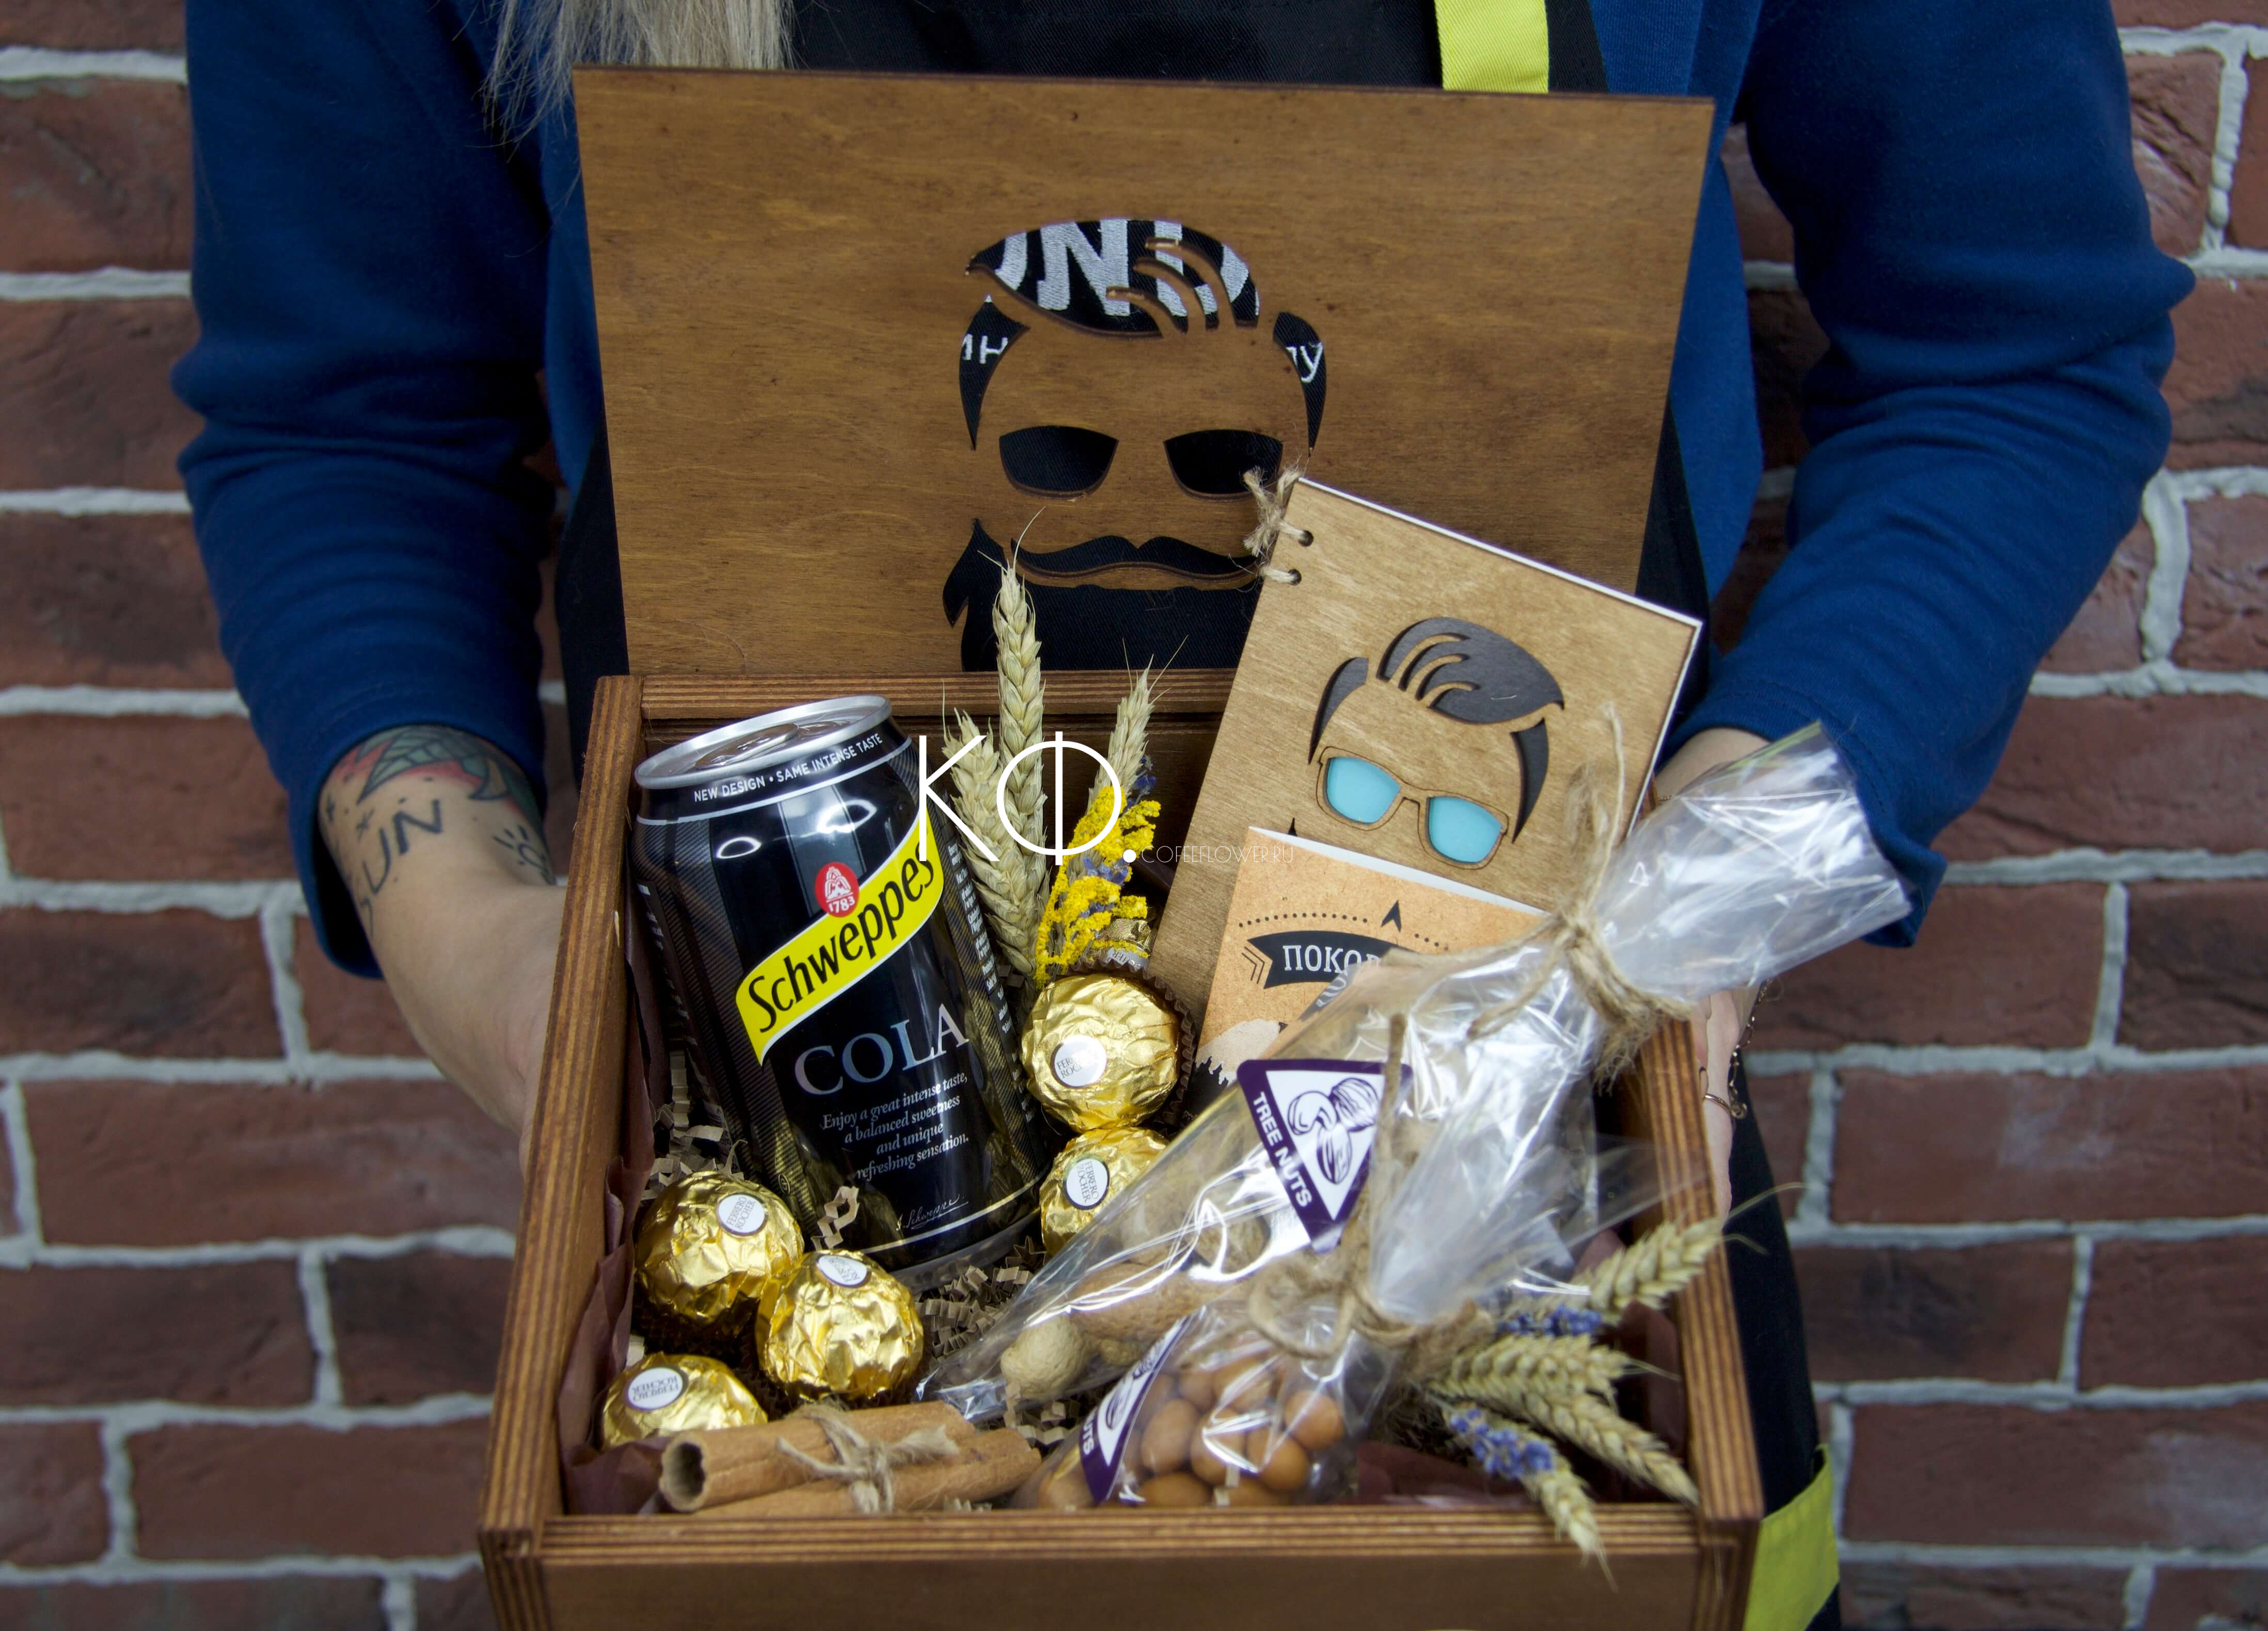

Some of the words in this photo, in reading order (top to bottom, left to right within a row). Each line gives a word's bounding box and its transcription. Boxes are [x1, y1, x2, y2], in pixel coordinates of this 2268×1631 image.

[694, 787, 718, 803] NEW
[722, 776, 766, 797] DESIGN
[776, 765, 811, 783] SAME
[812, 746, 857, 772] INTENSE
[855, 733, 883, 753] TASTE
[829, 896, 855, 913] 1783
[748, 842, 934, 1033] Schweppes
[795, 1003, 969, 1095] COLA
[820, 1111, 857, 1130] Enjoy
[860, 1111, 868, 1121] a
[870, 1098, 900, 1122] great
[903, 1083, 941, 1107] intense
[943, 1072, 968, 1092] taste,
[844, 1133, 852, 1144] a
[855, 1110, 909, 1141] balanced
[911, 1095, 960, 1124] sweetness
[856, 1154, 916, 1182] refreshing
[916, 1133, 969, 1159] sensation.
[877, 1133, 901, 1155] and
[903, 1123, 944, 1145] unique
[1253, 1091, 1283, 1146] TREE
[1275, 1146, 1312, 1207] NUTS
[1084, 1161, 1099, 1200] FERRERO
[726, 1195, 748, 1225] FERRERO
[735, 1200, 757, 1230] ROCHER
